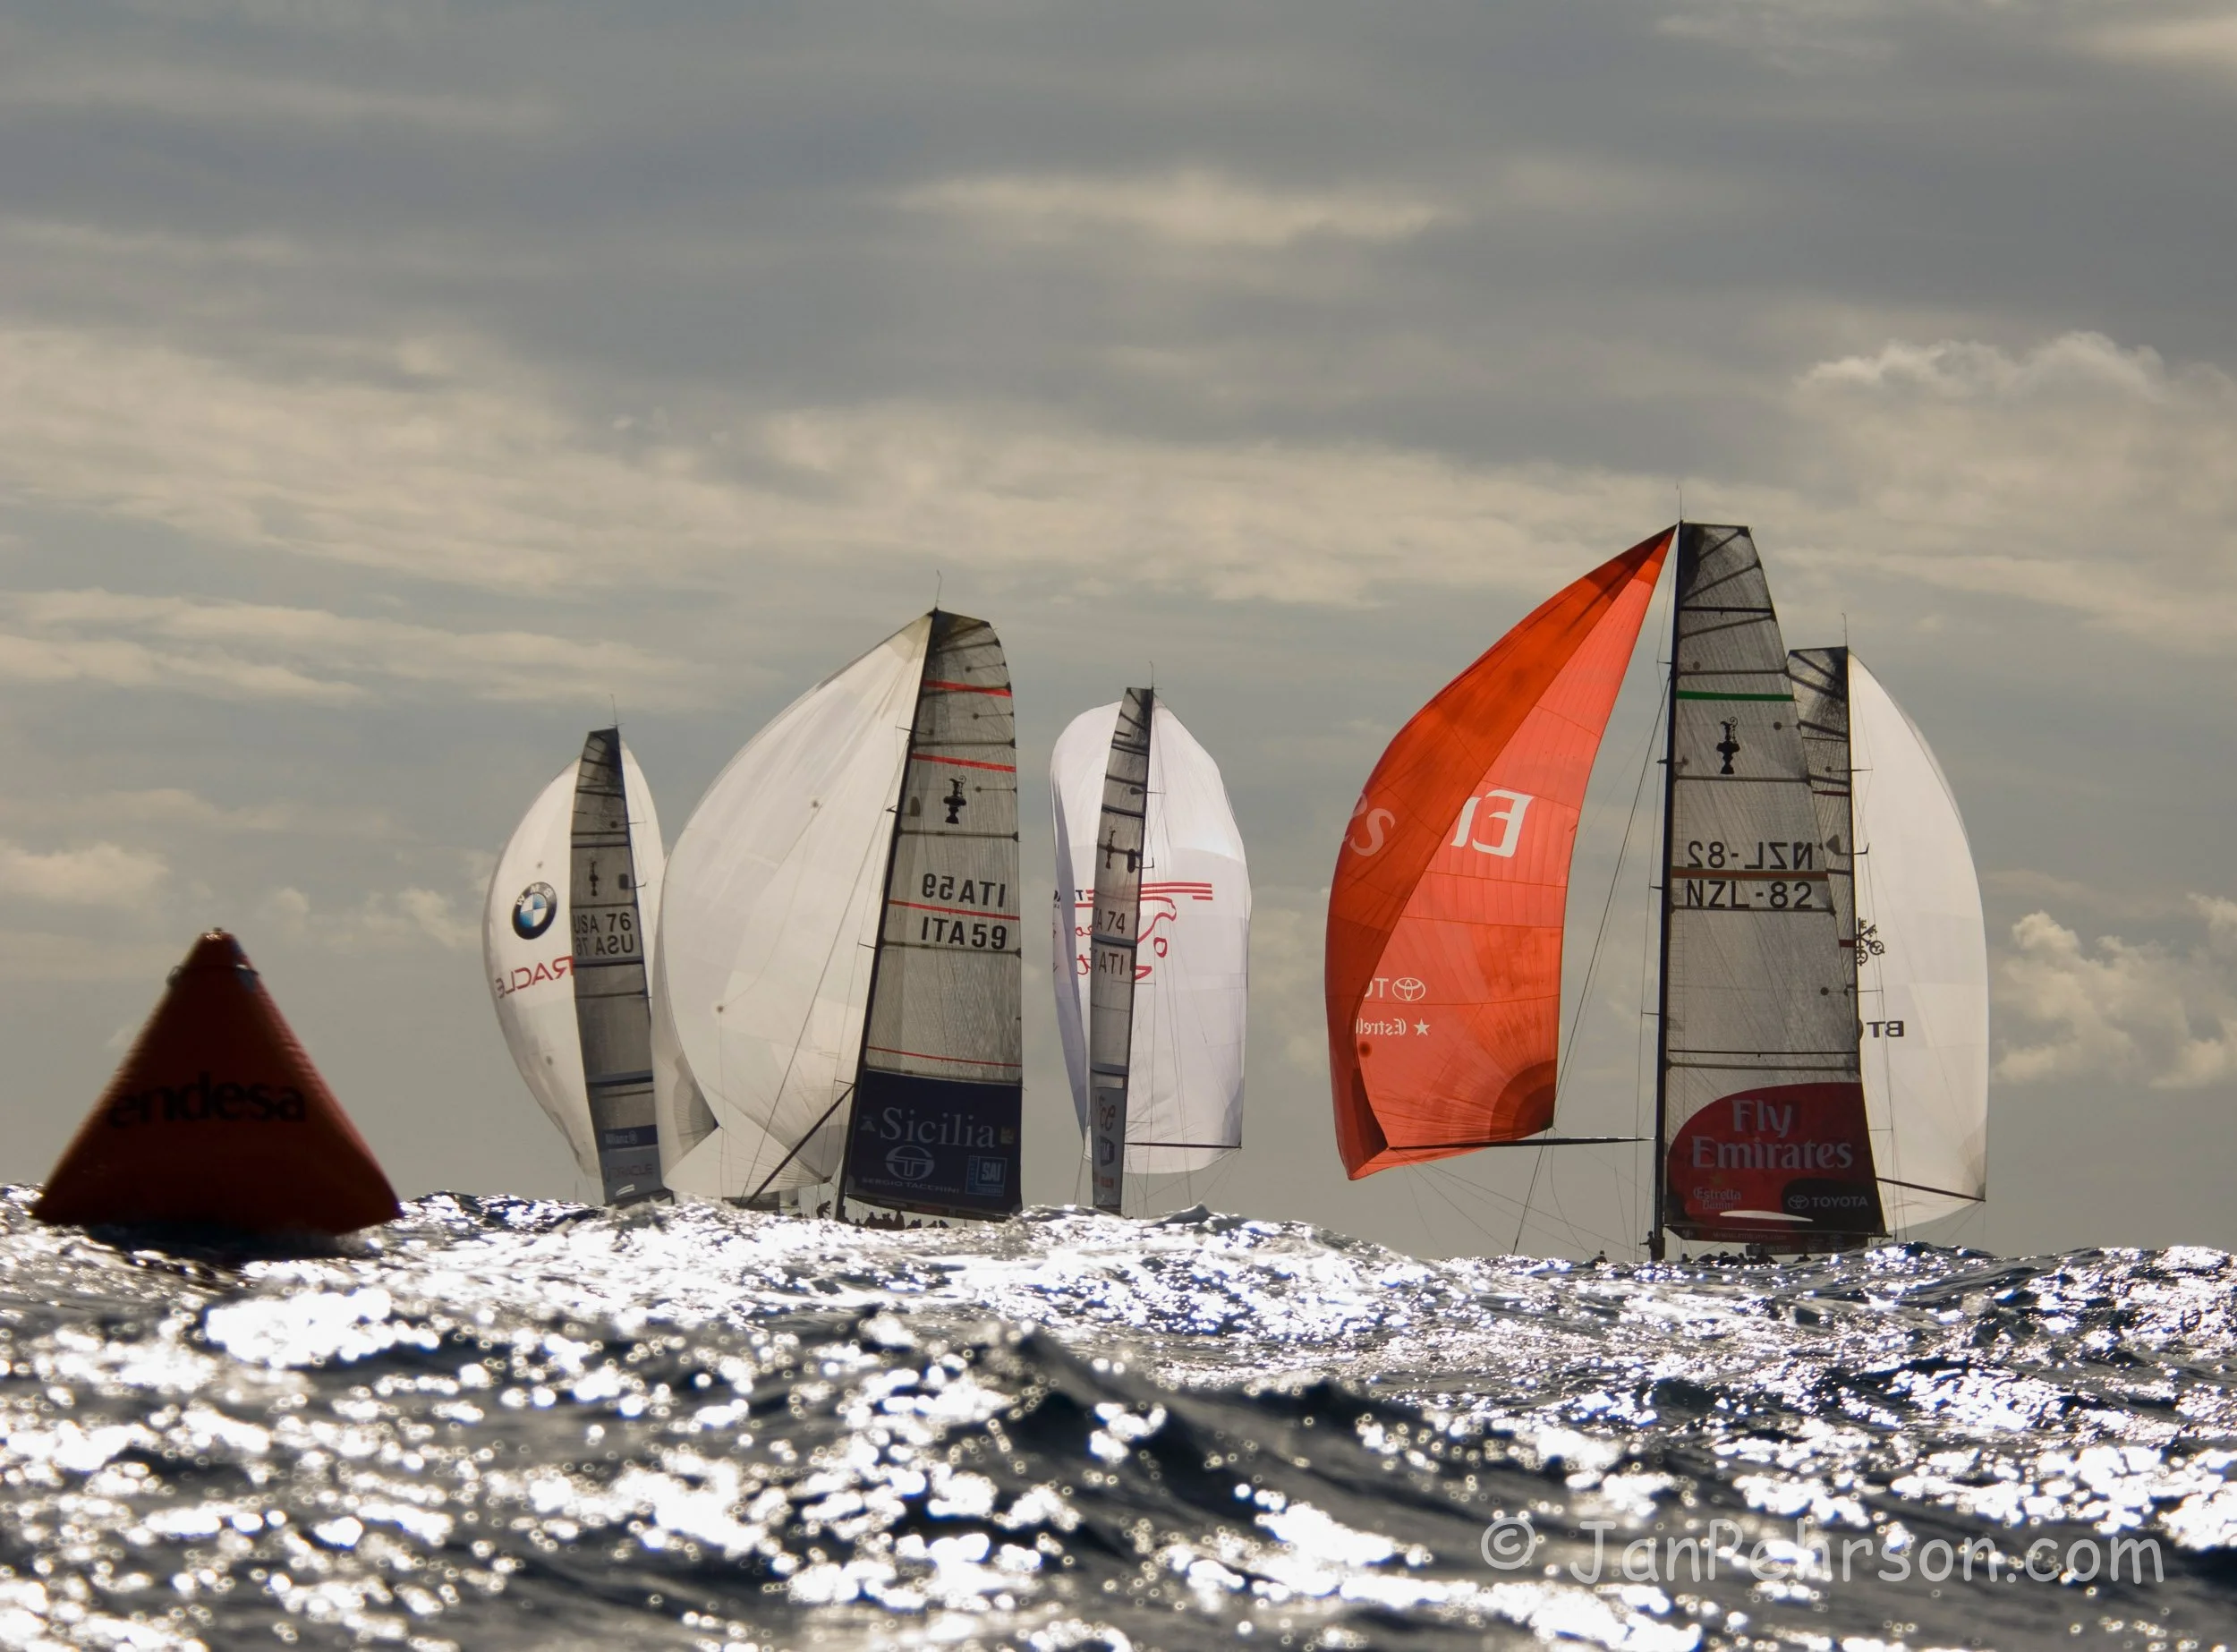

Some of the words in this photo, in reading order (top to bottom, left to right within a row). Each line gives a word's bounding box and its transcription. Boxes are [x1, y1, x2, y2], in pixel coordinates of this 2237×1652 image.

[1687, 879, 1813, 909] NZL-82
[606, 912, 632, 932] 76
[1108, 910, 1126, 934] 74
[106, 1071, 306, 1128] endesa
[880, 1106, 996, 1149] Sicilia
[1731, 1099, 1792, 1139] Fly
[1690, 1135, 1854, 1170] Emirates
[1811, 1195, 1869, 1209] TOYOTA
